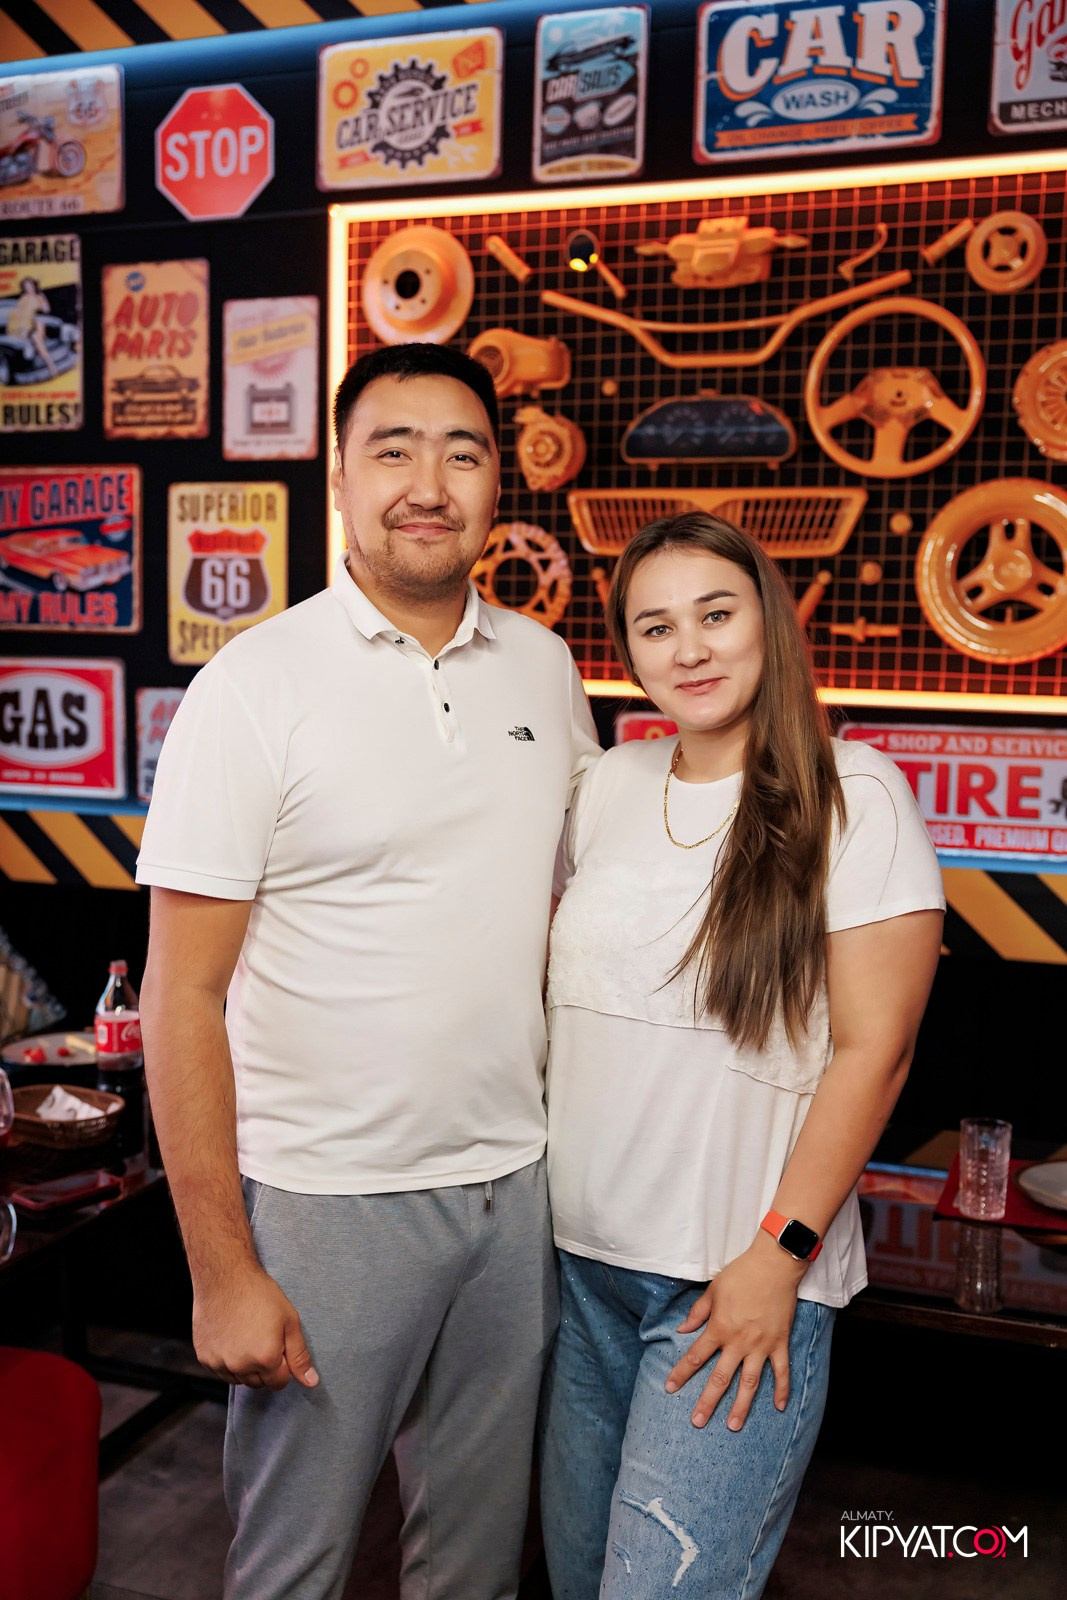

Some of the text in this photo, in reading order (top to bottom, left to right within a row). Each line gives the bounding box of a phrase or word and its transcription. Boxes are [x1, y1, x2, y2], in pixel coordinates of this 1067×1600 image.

[718, 0, 925, 99] CAR
[337, 83, 479, 149] CAR SERVICE
[782, 91, 850, 110] WASH
[165, 126, 264, 181] STOP
[0, 238, 80, 264] GARAGE
[114, 291, 199, 329] AUTO
[111, 328, 198, 361] PARTS
[30, 474, 127, 520] GARAGE
[177, 492, 277, 523] SUPERIOR
[201, 558, 251, 609] 66
[39, 591, 118, 625] RULES
[0, 687, 88, 750] GAS
[888, 734, 941, 753] SHOP
[944, 736, 987, 755] AND
[895, 761, 1042, 820] TIRE
[975, 825, 1049, 851] PREMIUM
